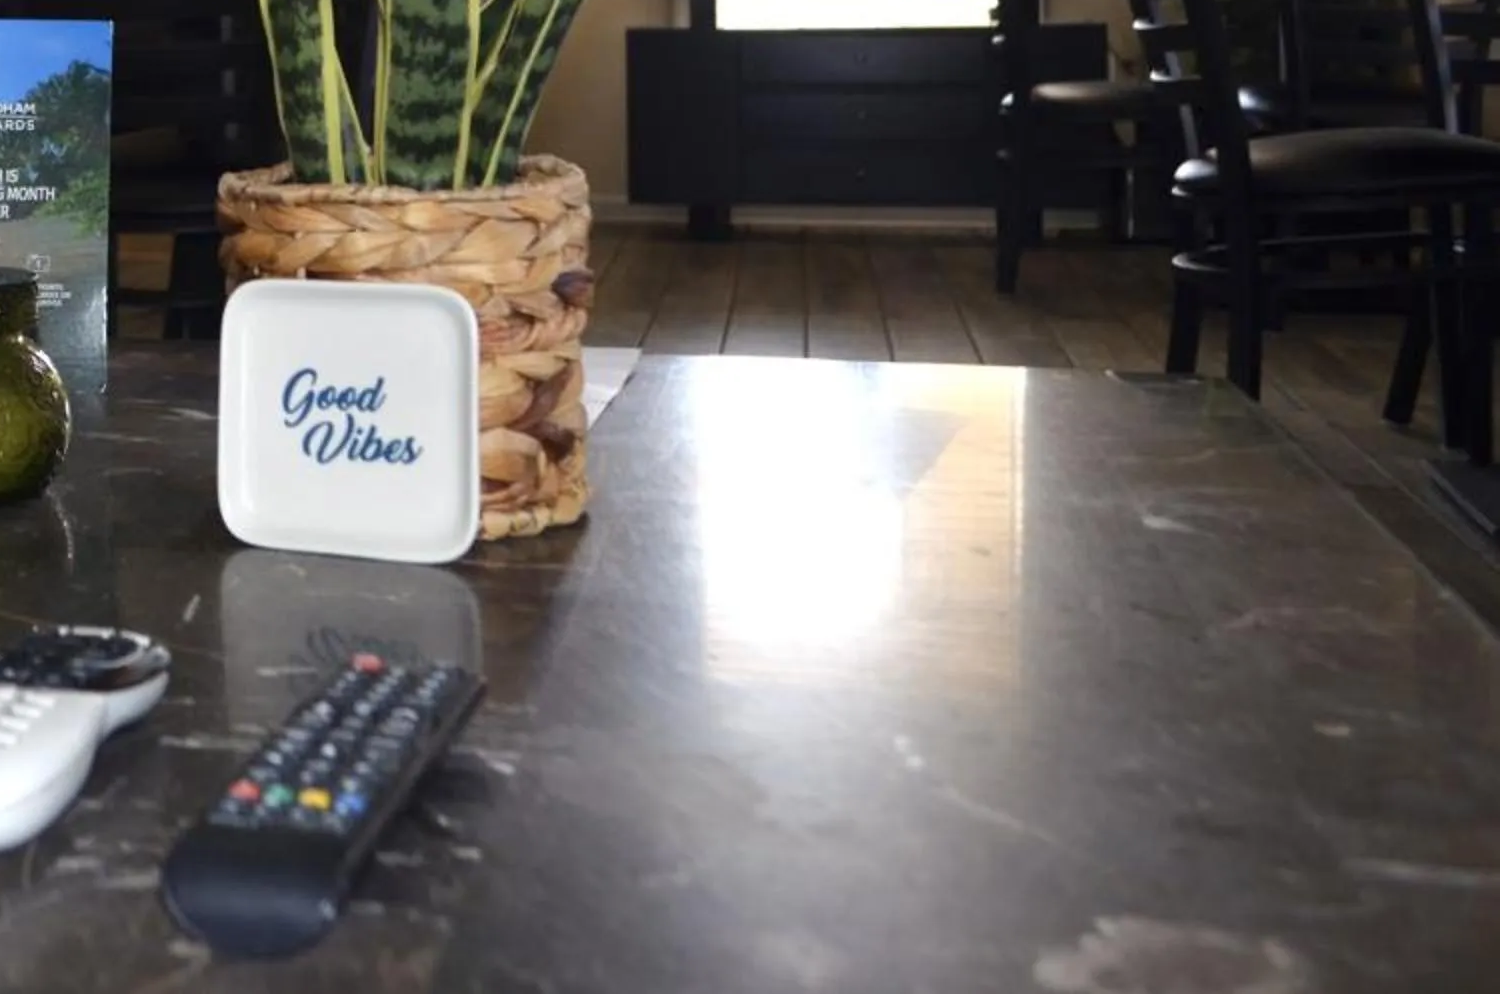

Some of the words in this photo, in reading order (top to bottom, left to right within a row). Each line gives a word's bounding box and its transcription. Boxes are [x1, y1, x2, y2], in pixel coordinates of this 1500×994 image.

[6, 169, 19, 183] IS
[7, 187, 56, 201] MONTH
[282, 368, 386, 428] Good
[302, 413, 423, 464] Vibes
